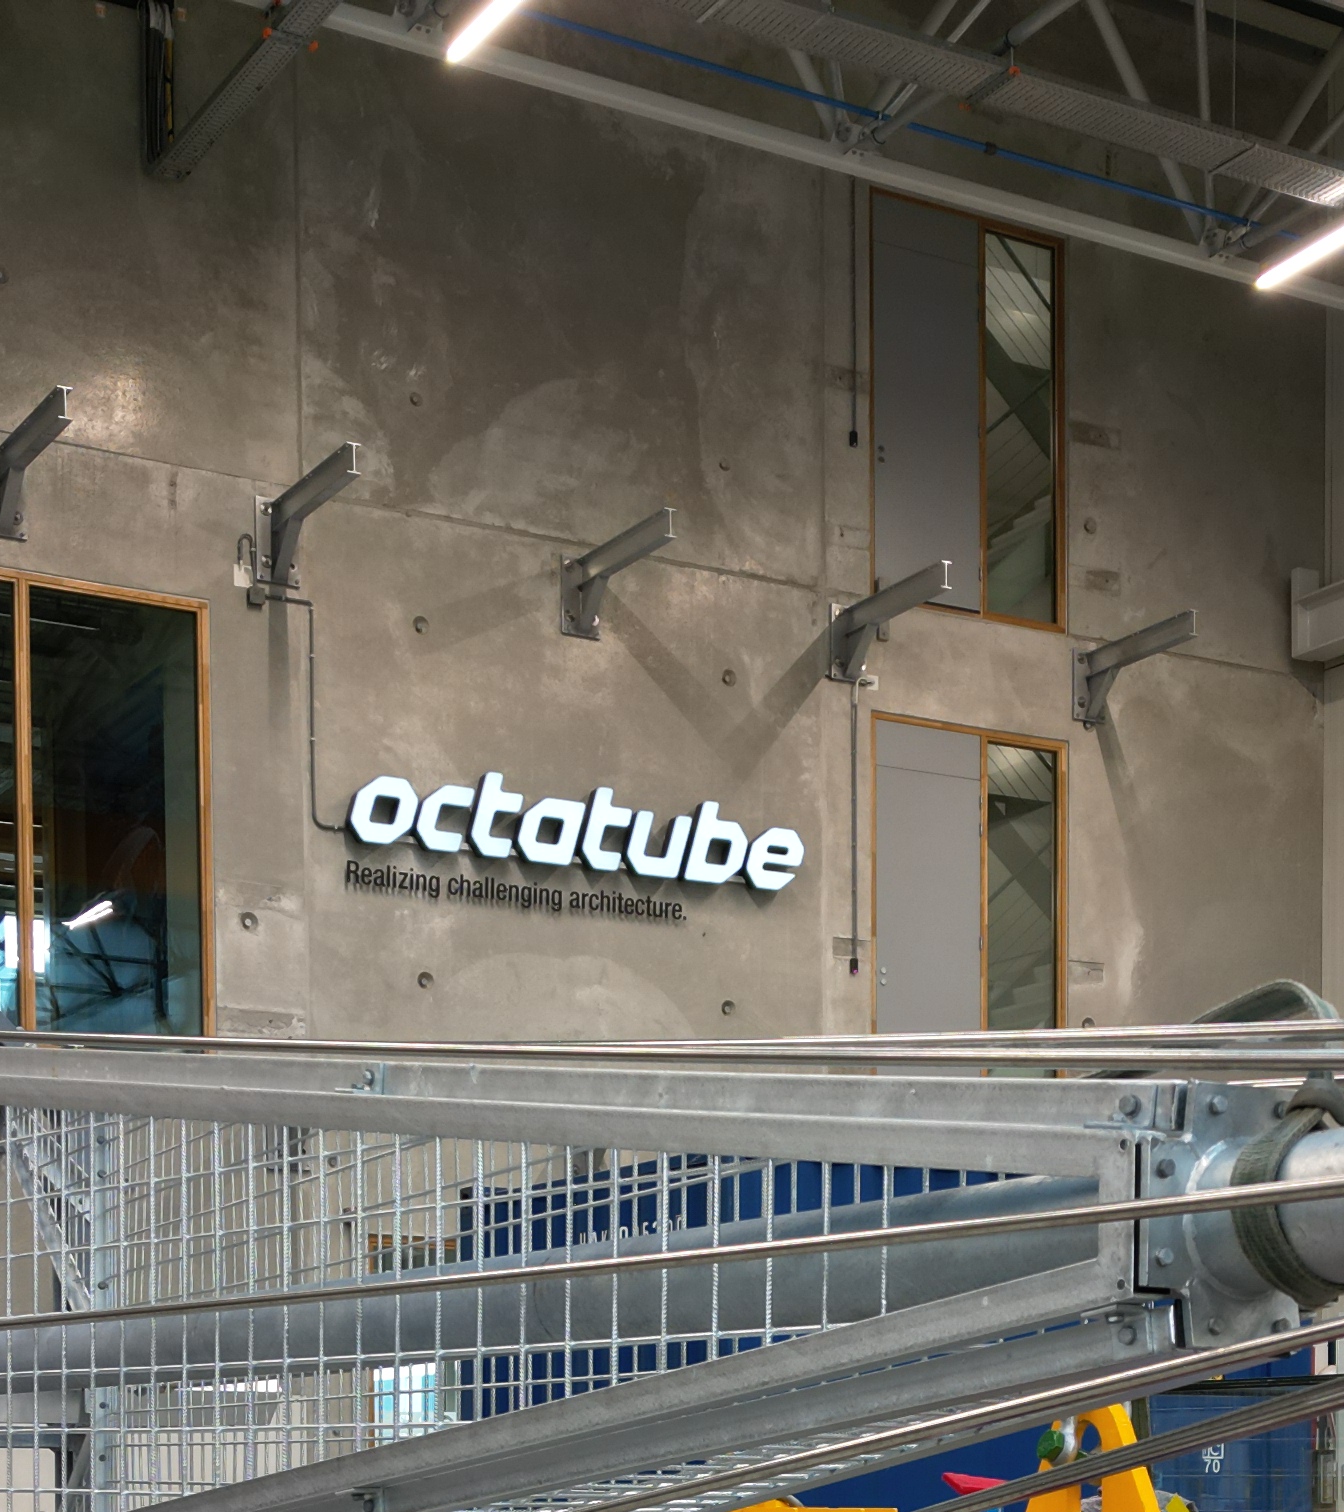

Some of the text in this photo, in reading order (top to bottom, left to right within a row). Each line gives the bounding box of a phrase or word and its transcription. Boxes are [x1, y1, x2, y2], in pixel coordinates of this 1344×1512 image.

[348, 771, 805, 891] octatube
[346, 860, 688, 921] Realizing challenging architecture.
[1203, 1459, 1221, 1473] 70
